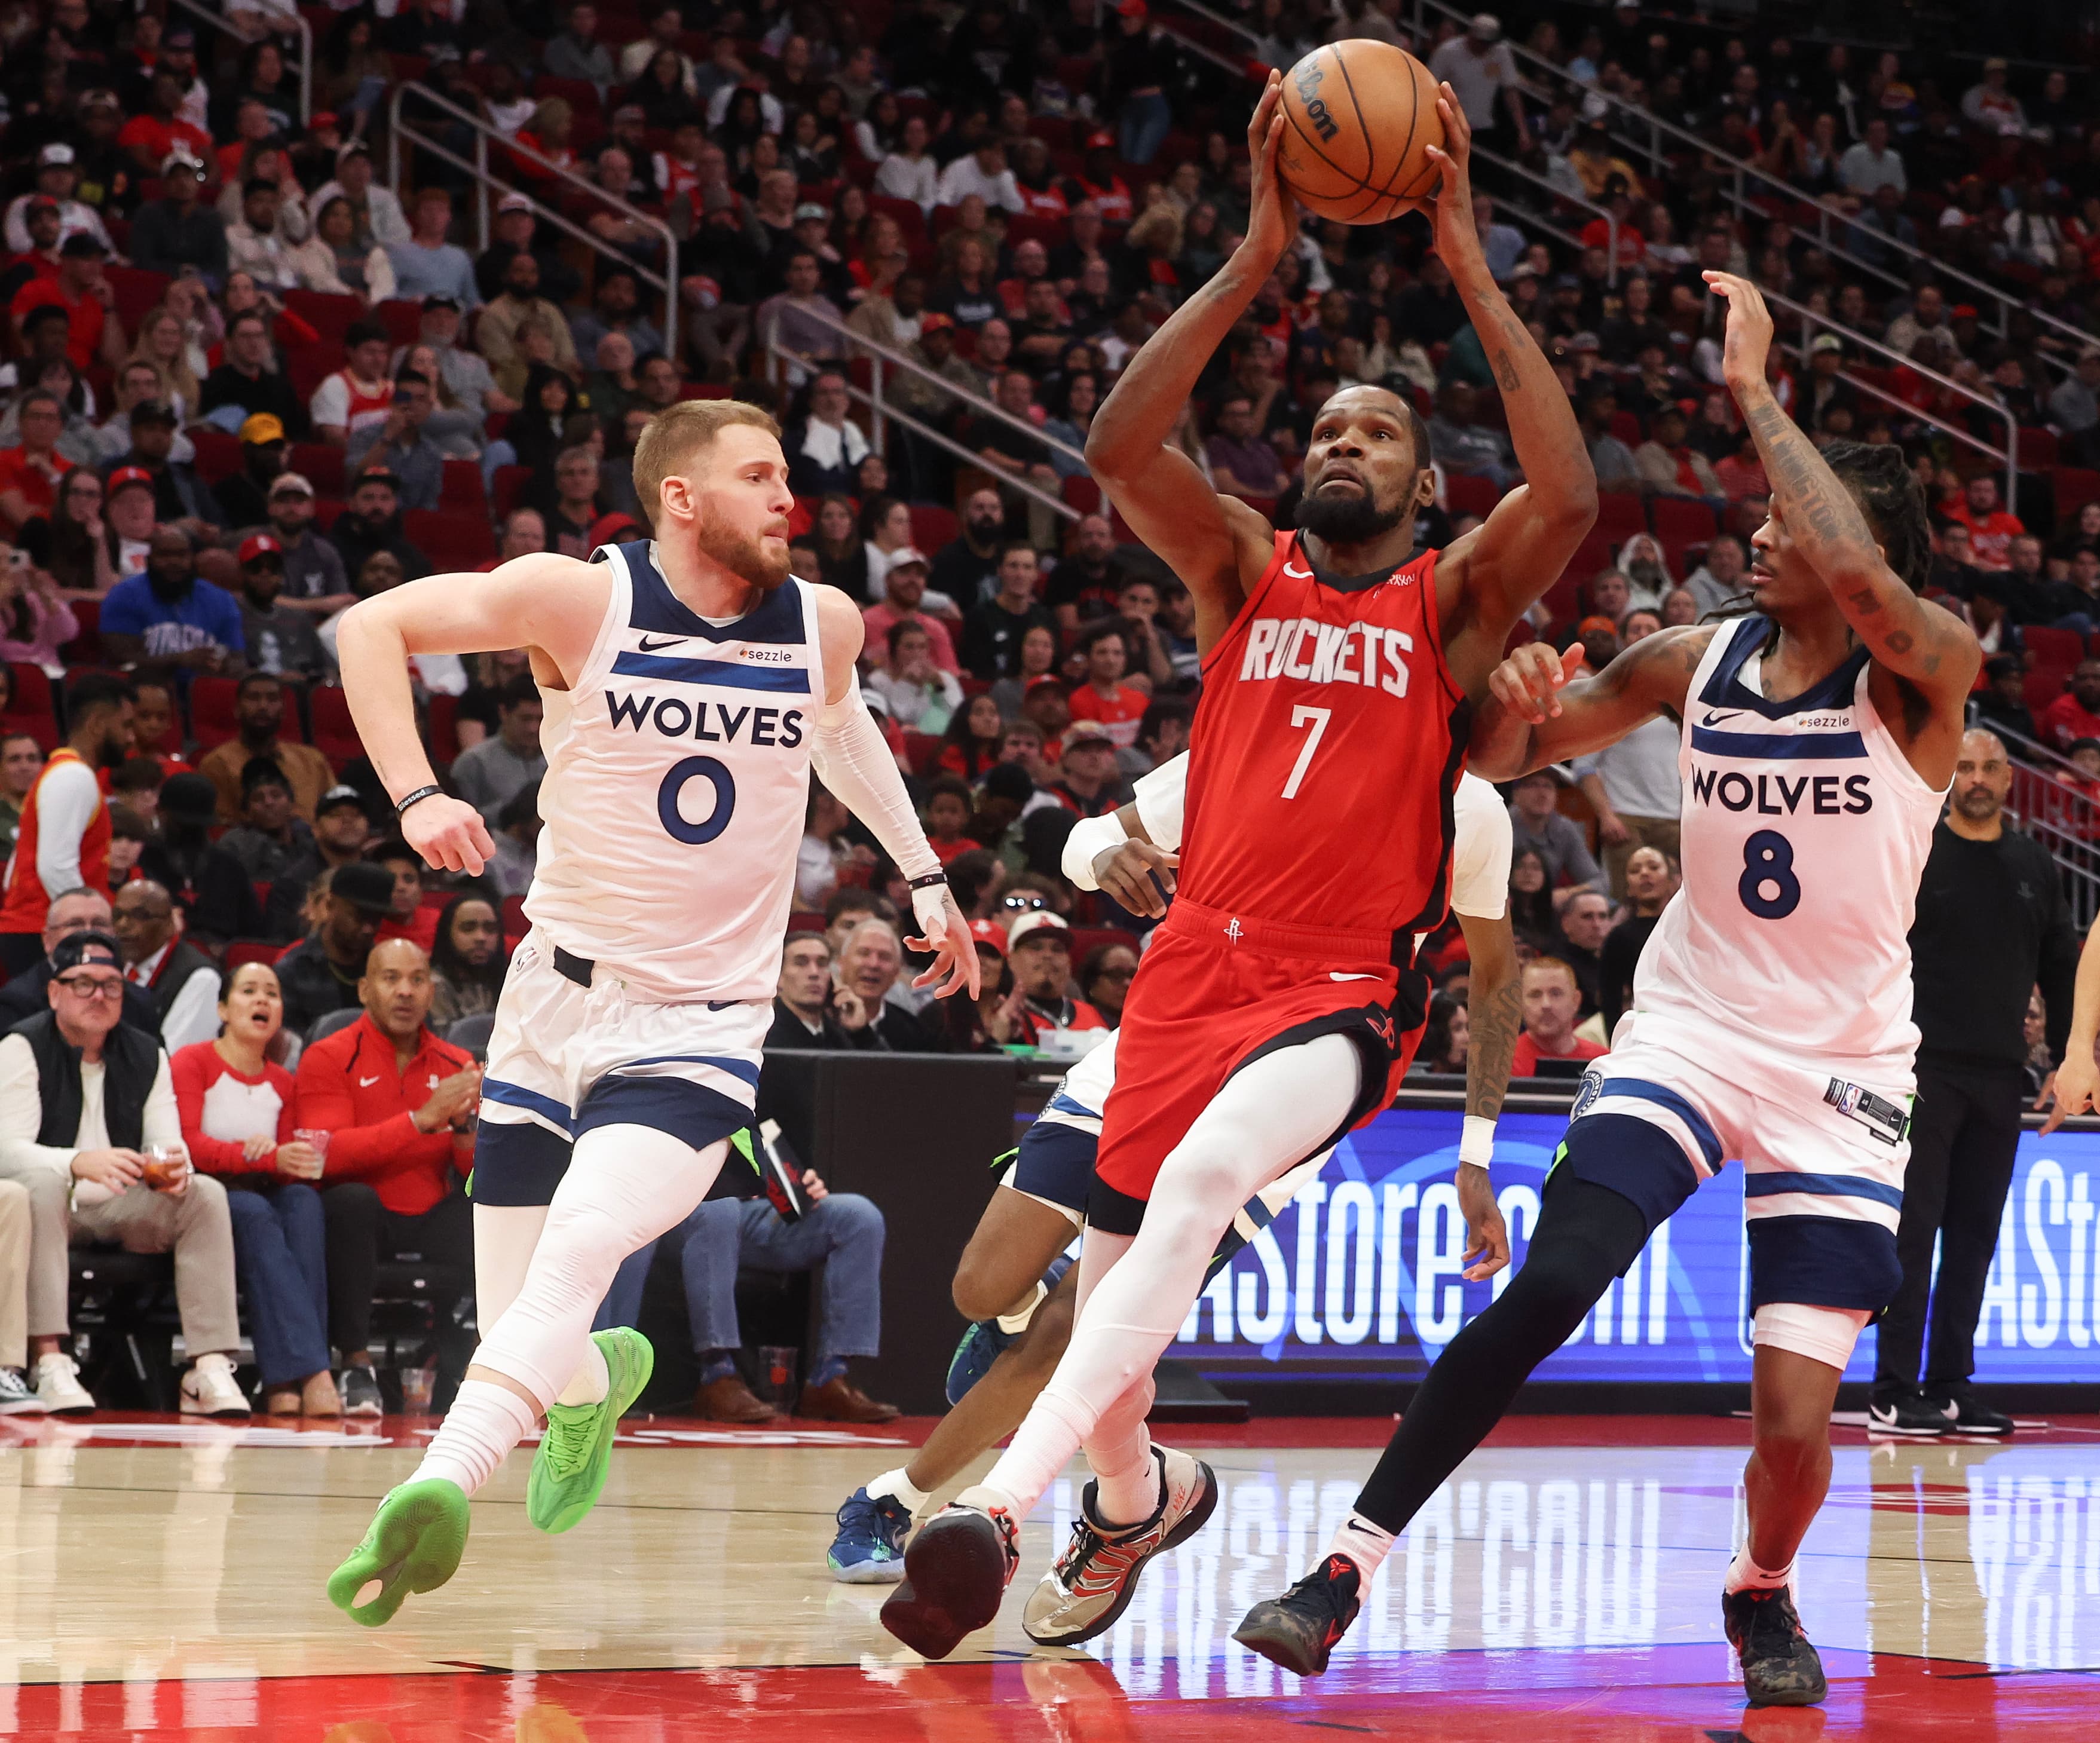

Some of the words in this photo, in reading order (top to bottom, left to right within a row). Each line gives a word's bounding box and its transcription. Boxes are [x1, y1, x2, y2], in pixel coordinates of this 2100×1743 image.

[748, 649, 792, 662] sezzle
[1239, 617, 1413, 699] ROCKETS
[605, 690, 804, 749] WOLVES
[1281, 704, 1331, 799] 7
[1807, 715, 1850, 727] sezzle
[658, 755, 736, 844] 0
[1691, 761, 1872, 816] WOLVES
[1738, 829, 1801, 919] 8
